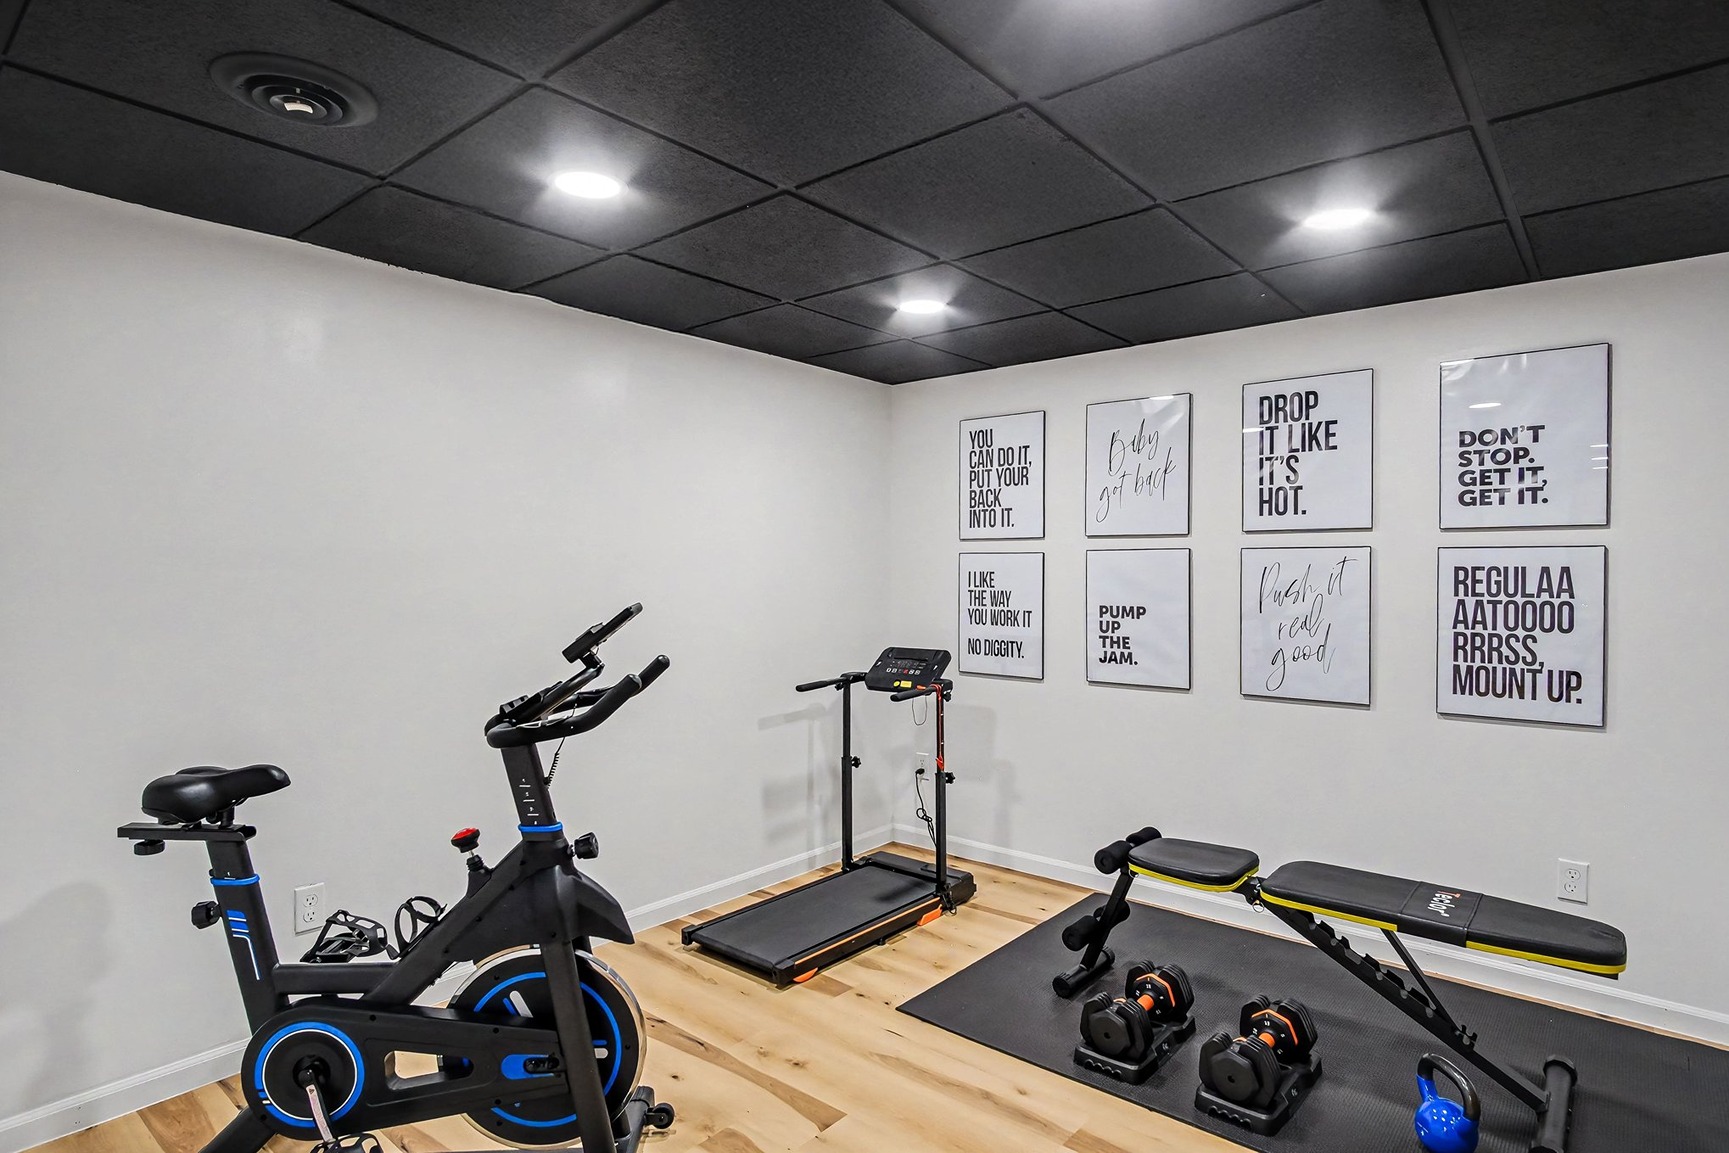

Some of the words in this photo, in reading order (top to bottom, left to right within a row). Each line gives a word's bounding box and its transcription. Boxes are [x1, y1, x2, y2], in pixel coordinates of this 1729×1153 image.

[1259, 391, 1318, 425] DROP
[969, 429, 993, 449] YOU
[1108, 418, 1159, 477] Baby
[1259, 425, 1279, 455] IT
[1288, 420, 1338, 453] LIKE
[1459, 425, 1545, 448] DON'T
[970, 449, 993, 469] CAN
[998, 447, 1014, 467] DO
[1018, 445, 1032, 467] IT,
[1458, 447, 1535, 467] STOP.
[970, 468, 993, 489] PUT
[996, 466, 1029, 487] YOUR
[1259, 455, 1299, 486] IT'S
[1458, 468, 1511, 487] GET
[1518, 466, 1548, 486] IT,
[1096, 471, 1132, 523] got
[1135, 446, 1177, 501] back
[970, 488, 1002, 508] BACK
[1259, 485, 1306, 516] HOT.
[1458, 488, 1511, 506] GET
[1518, 487, 1548, 505] IT.
[970, 508, 997, 528] INTO
[1002, 508, 1015, 529] IT.
[974, 571, 995, 588] LIKE
[1259, 562, 1320, 613] Push
[1328, 556, 1358, 596] it
[1454, 566, 1575, 599] REGULAA
[968, 590, 987, 606] THE
[990, 590, 1011, 607] WAY
[968, 608, 987, 625] YOU
[990, 609, 1020, 627] WORK
[1023, 610, 1032, 627] IT
[1099, 605, 1146, 619] PUMP
[1278, 593, 1323, 640] real
[1452, 599, 1575, 634] AATOOOO
[1099, 620, 1121, 634] UP
[968, 638, 981, 655] NO
[984, 639, 1024, 658] DIGGITY.
[1099, 635, 1130, 650] THE
[1453, 632, 1544, 670] RRRSS,
[1099, 651, 1138, 665] JAM.
[1266, 623, 1335, 691] good
[1453, 664, 1543, 700] MOUNT
[1547, 669, 1582, 704] UP.
